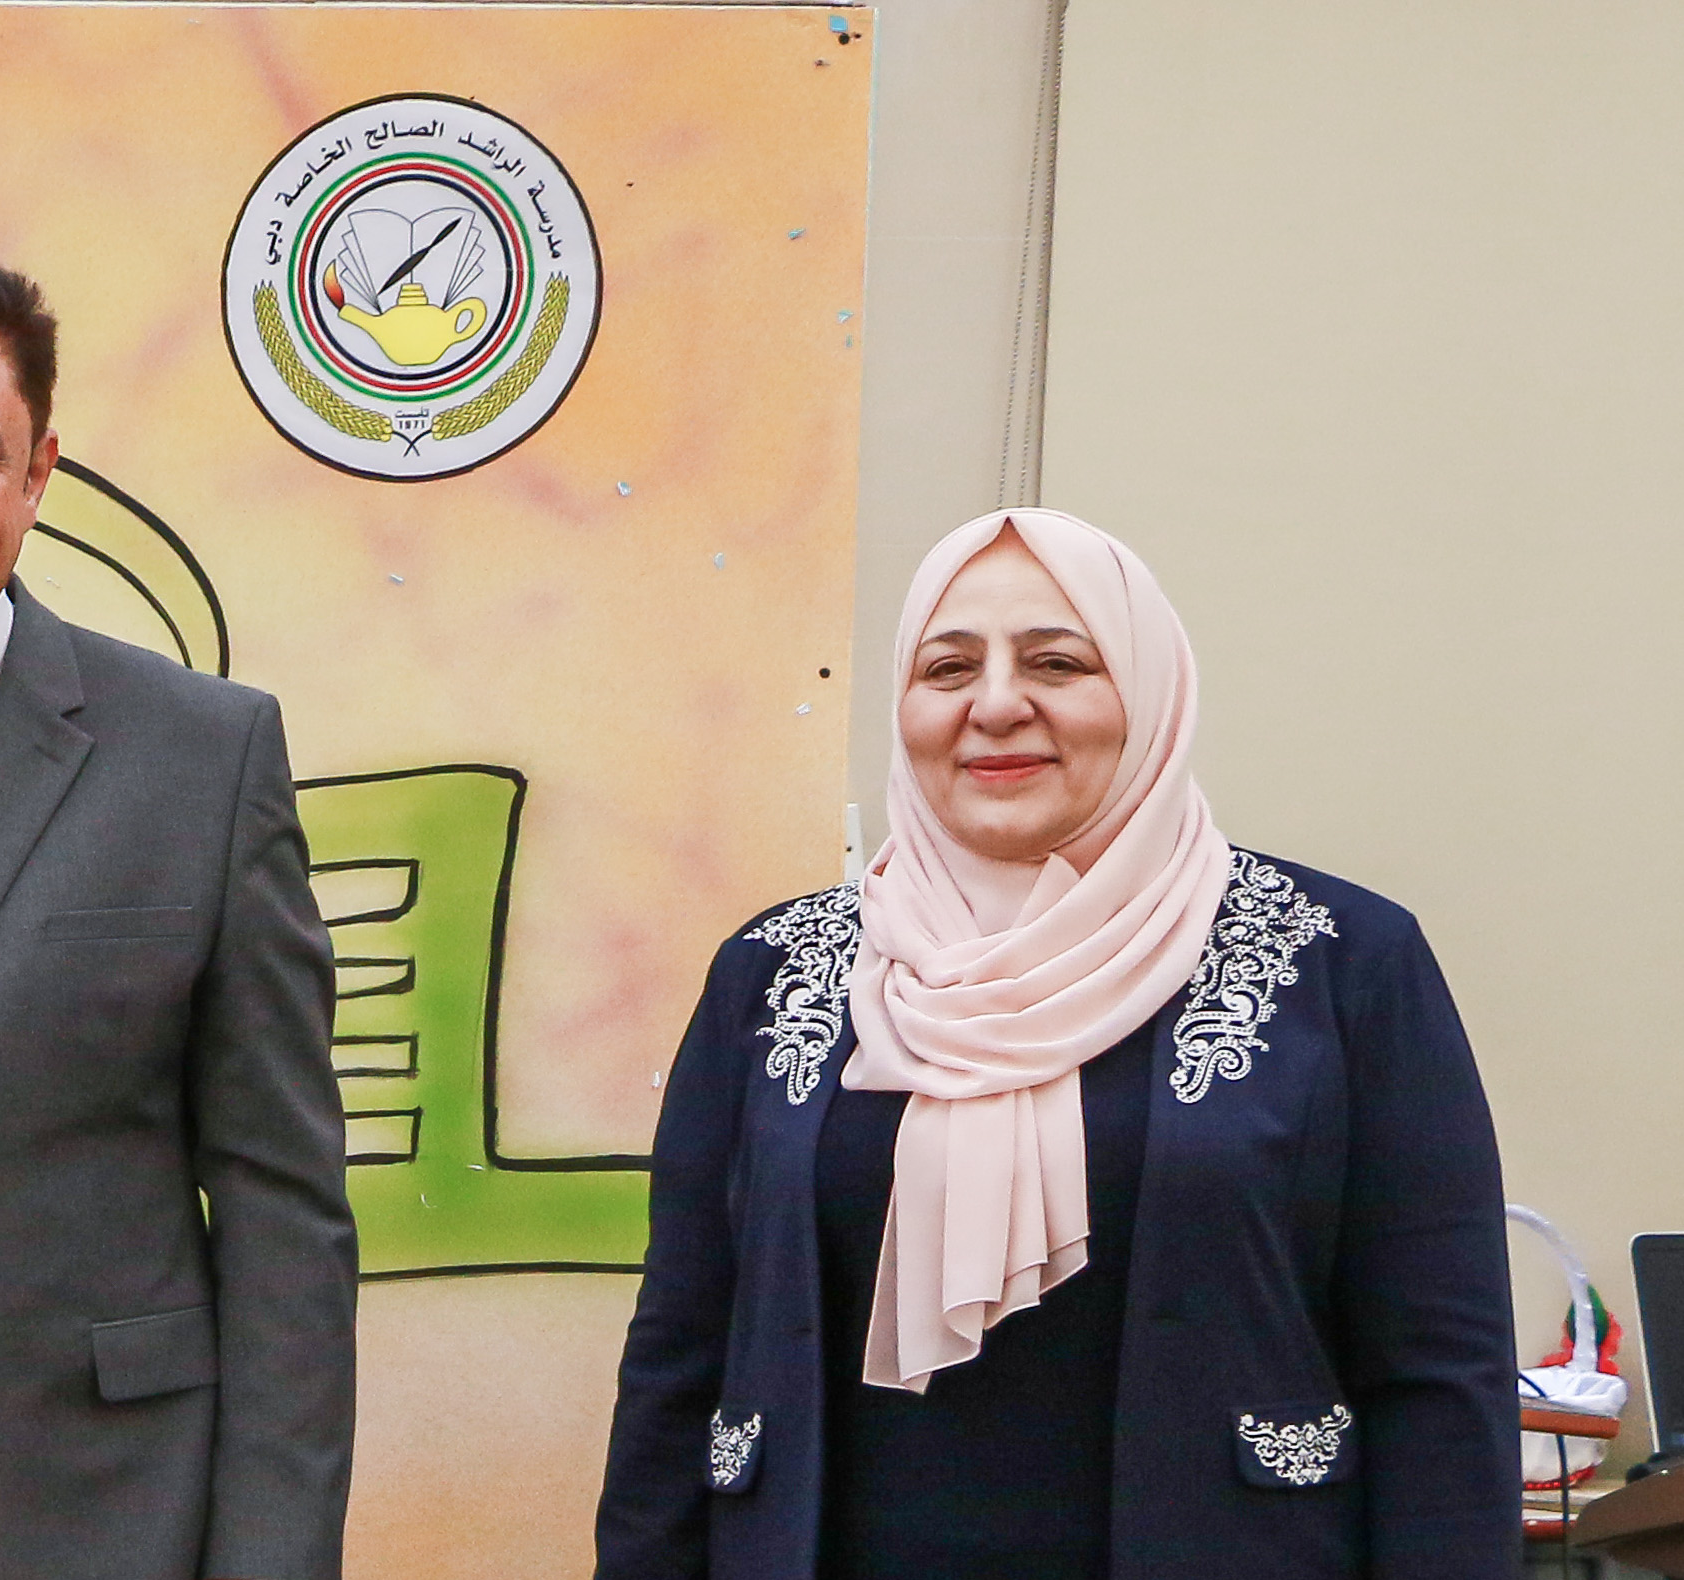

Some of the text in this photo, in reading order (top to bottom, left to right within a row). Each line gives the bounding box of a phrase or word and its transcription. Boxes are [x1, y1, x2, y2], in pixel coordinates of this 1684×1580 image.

[265, 121, 562, 266] مدرسة الراشد الصالح الخاصة دبي
[399, 420, 425, 429] 1971
